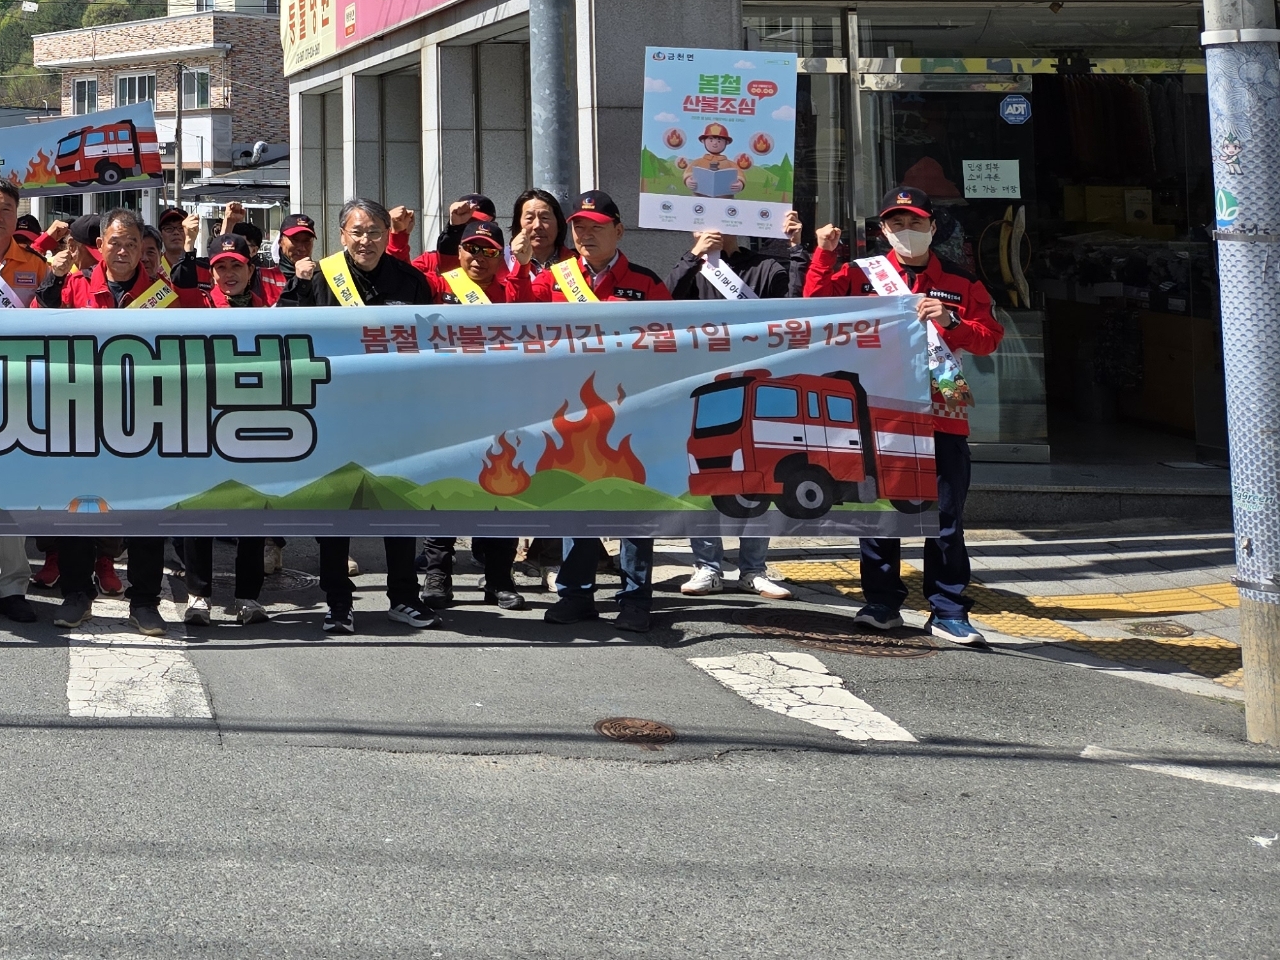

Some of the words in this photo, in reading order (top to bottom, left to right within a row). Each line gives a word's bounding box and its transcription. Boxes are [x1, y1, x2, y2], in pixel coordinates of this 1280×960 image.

[698, 73, 741, 96] 봄철
[682, 95, 757, 116] 산불조심
[1005, 103, 1027, 115] ADT
[360, 324, 418, 355] 봄철
[428, 323, 606, 355] 산불조심기간
[630, 322, 677, 354] 2월
[688, 321, 732, 352] 1일
[767, 319, 812, 351] 5월
[823, 318, 882, 349] 15일
